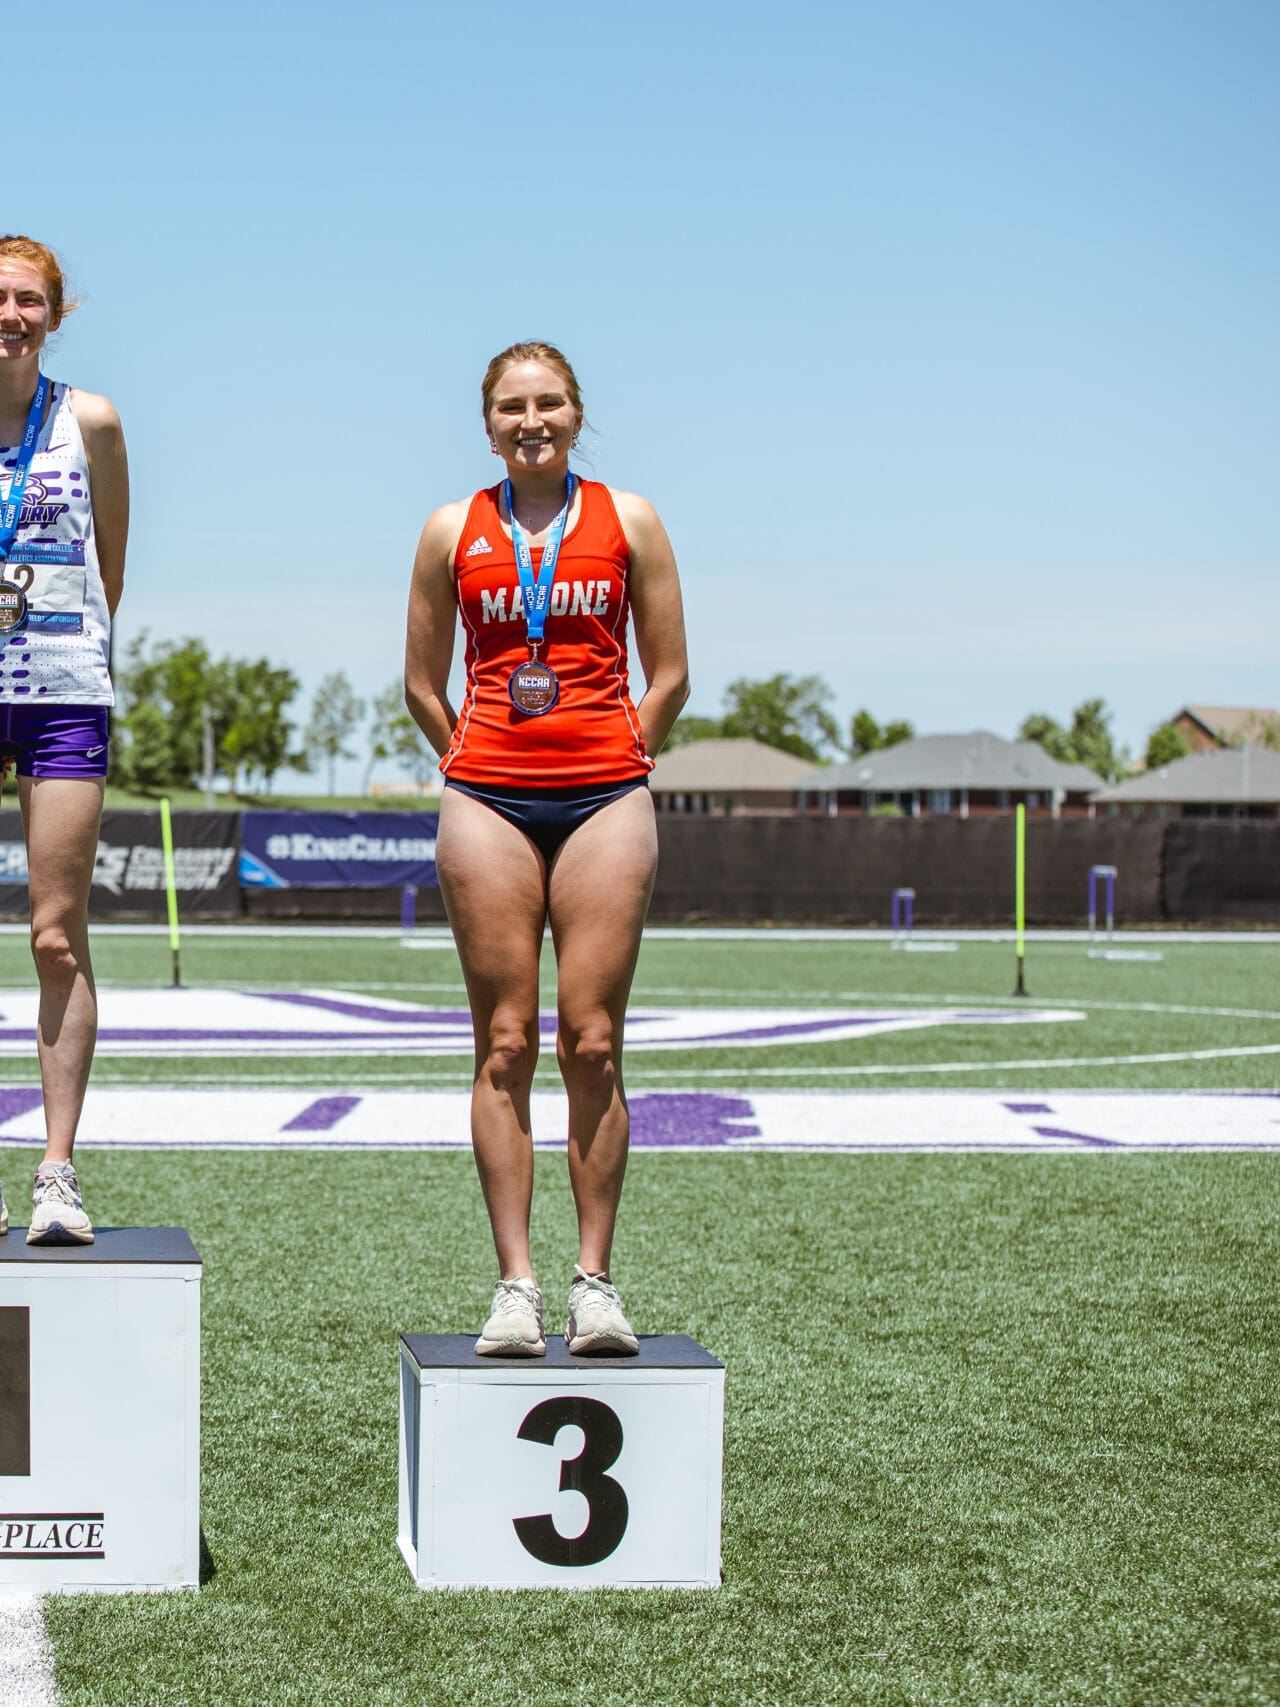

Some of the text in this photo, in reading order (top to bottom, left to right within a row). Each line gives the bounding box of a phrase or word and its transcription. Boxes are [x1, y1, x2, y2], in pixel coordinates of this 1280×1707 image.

[24, 425, 36, 447] NCCAA
[14, 464, 26, 486] NCCAA
[5, 504, 17, 528] NCCAA
[466, 547, 493, 557] adidas
[518, 544, 530, 568] NCCAA
[543, 544, 556, 567] NCCAA
[480, 580, 611, 624] MAONE
[535, 585, 548, 611] NCCAA
[518, 676, 550, 688] NCCAA
[512, 1396, 629, 1567] 3
[4, 1523, 104, 1549] PLACE
